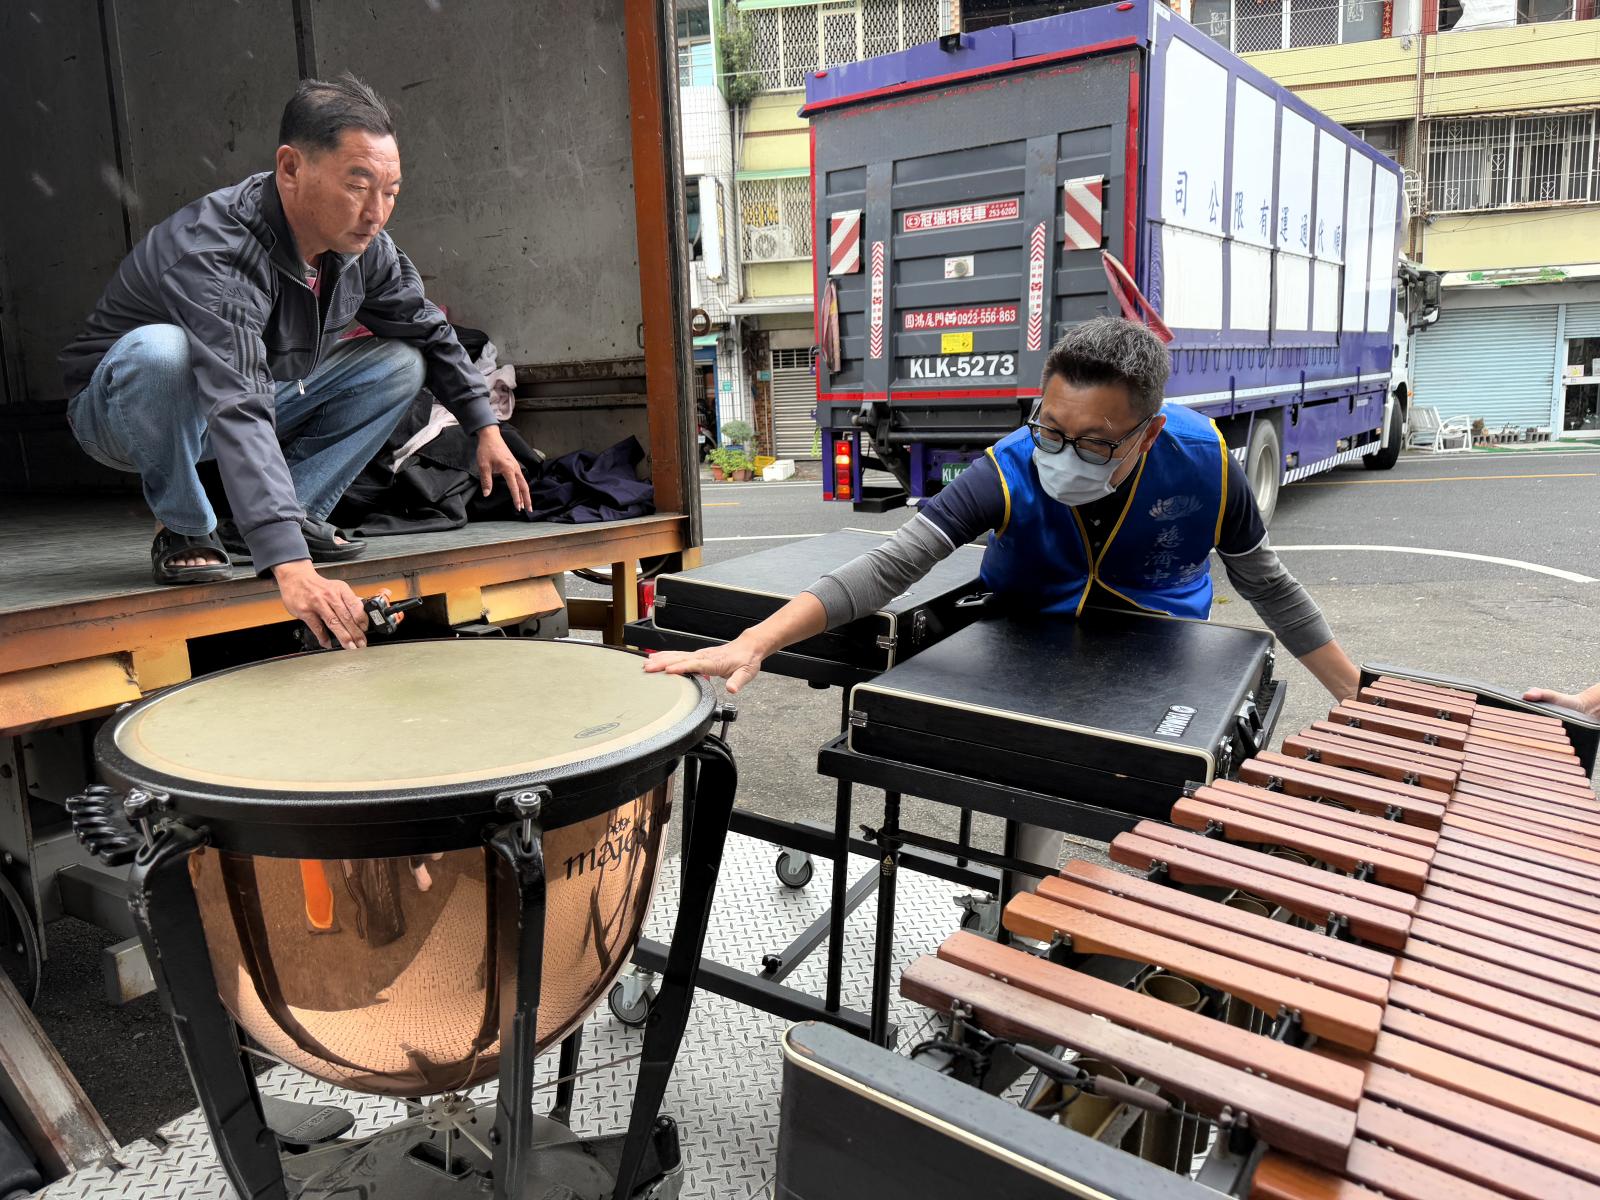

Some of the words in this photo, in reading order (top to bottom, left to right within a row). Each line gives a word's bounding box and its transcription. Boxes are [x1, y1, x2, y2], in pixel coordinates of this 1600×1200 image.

[920, 205, 986, 227] 冠瑞特裝車
[989, 206, 1016, 218] 253-6200
[957, 310, 1016, 325] 0923-556-863
[910, 354, 1015, 379] KLK-5273
